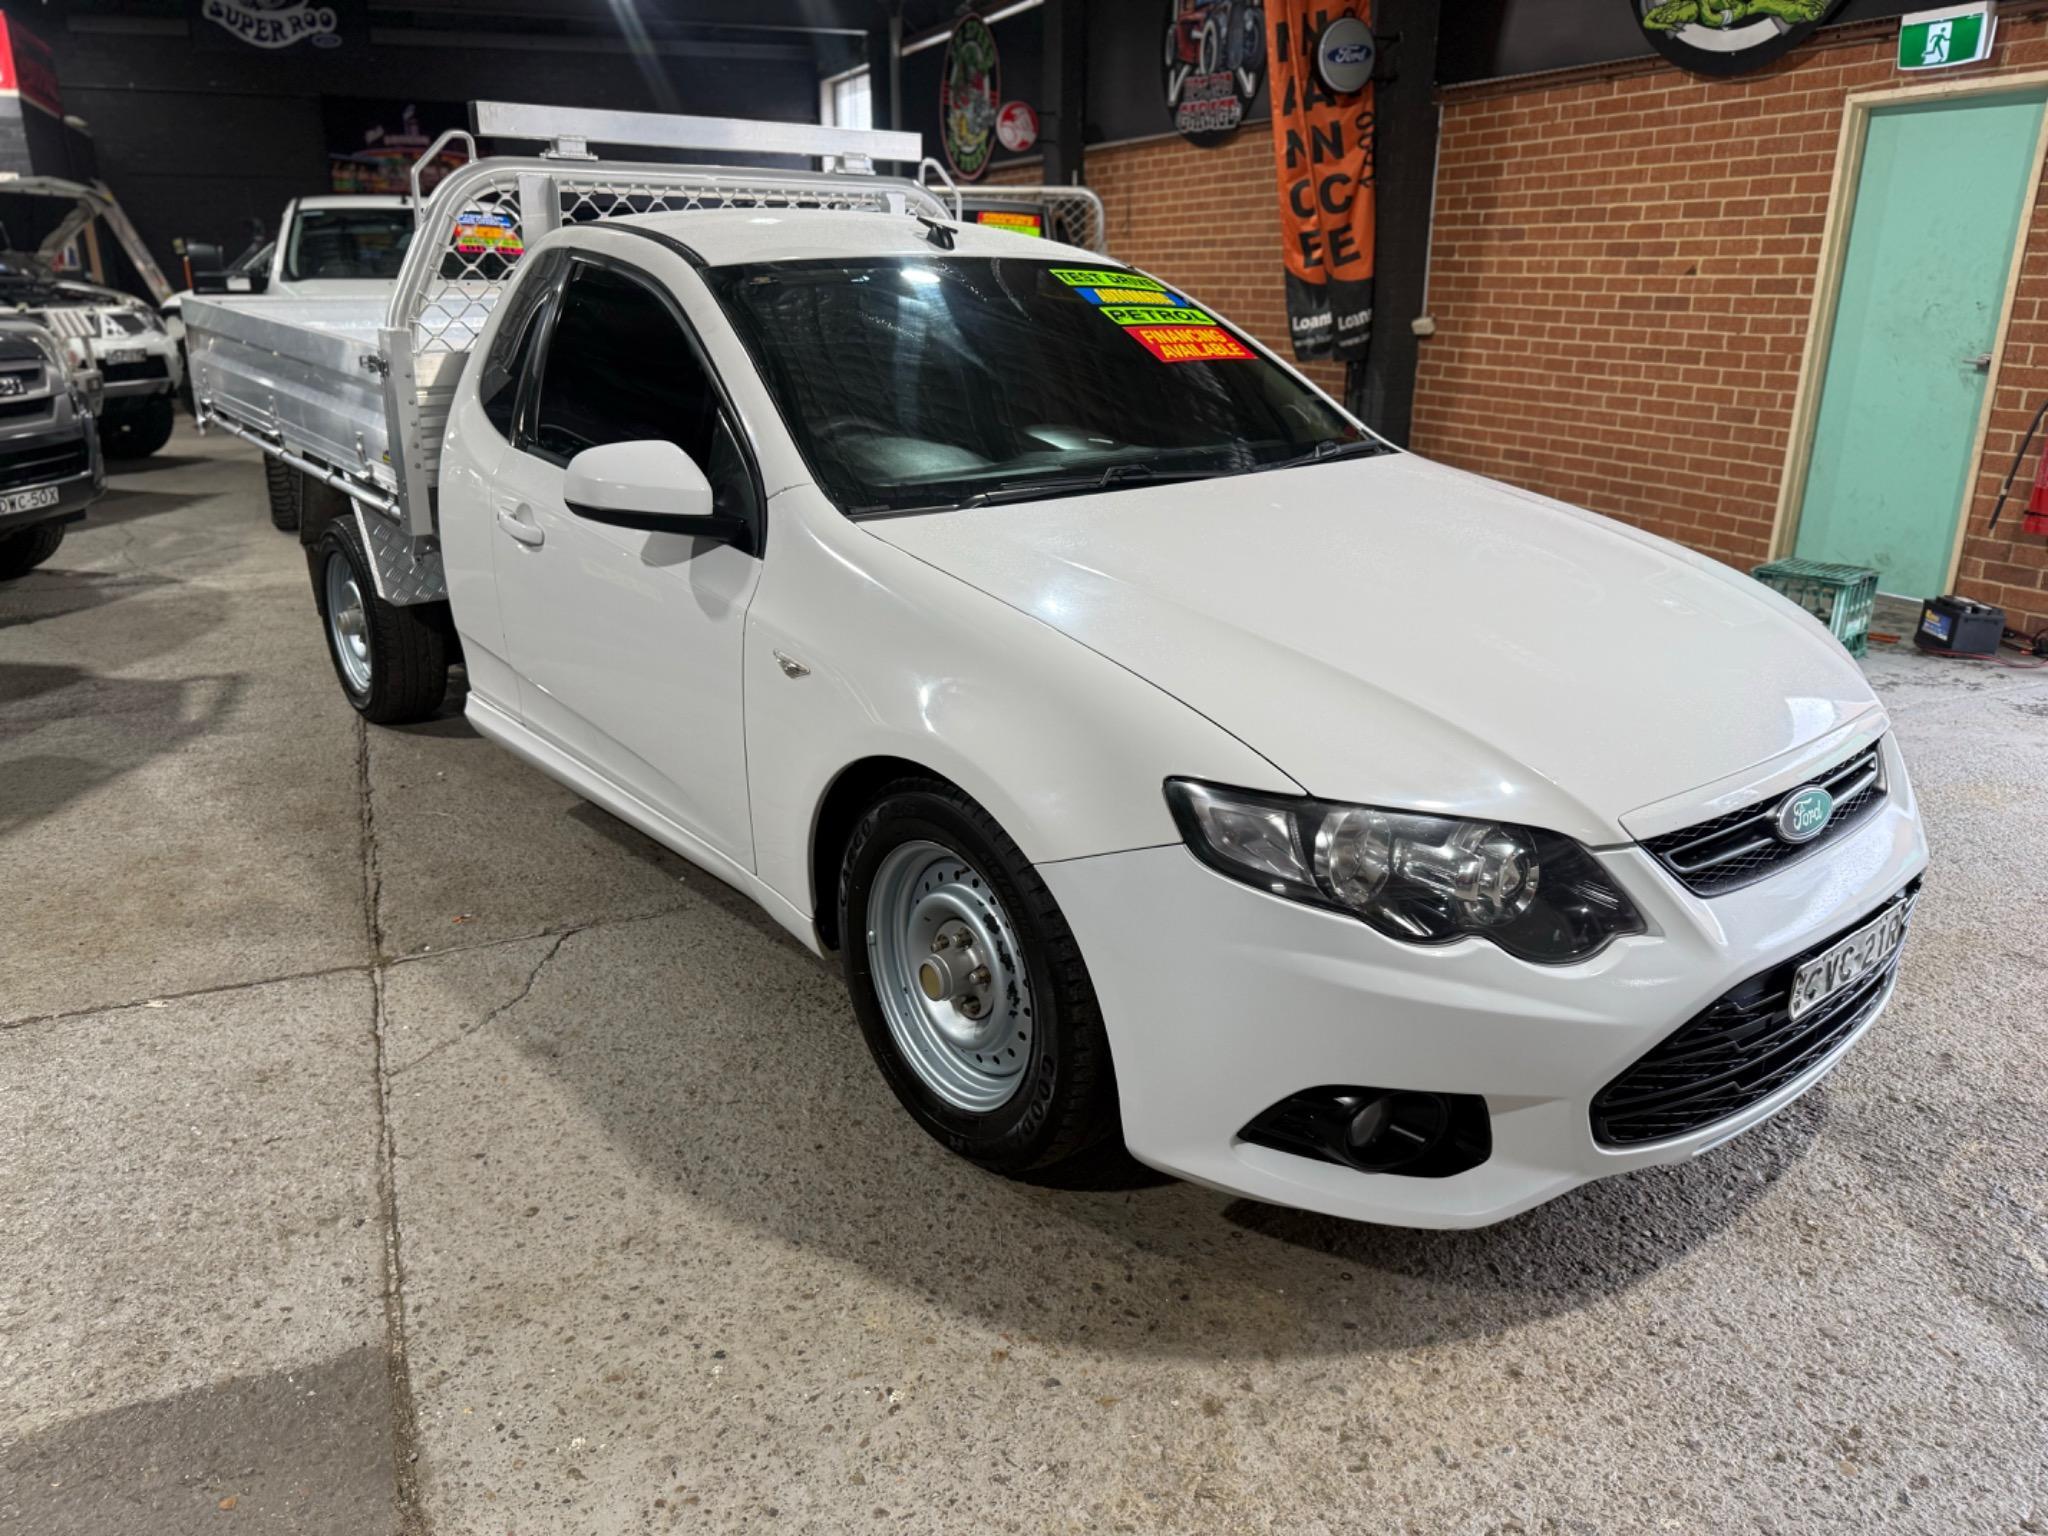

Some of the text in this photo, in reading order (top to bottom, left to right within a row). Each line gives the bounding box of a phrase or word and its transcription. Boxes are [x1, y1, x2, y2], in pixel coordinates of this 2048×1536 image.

[209, 2, 332, 43] SUPER ROO
[1334, 45, 1367, 63] Ford
[1054, 270, 1159, 289] TEST DRIVE
[1107, 308, 1209, 323] PETROL
[1139, 329, 1229, 344] FINANCING
[1159, 343, 1246, 359] AVAILABLE
[1793, 798, 1824, 831] Ford
